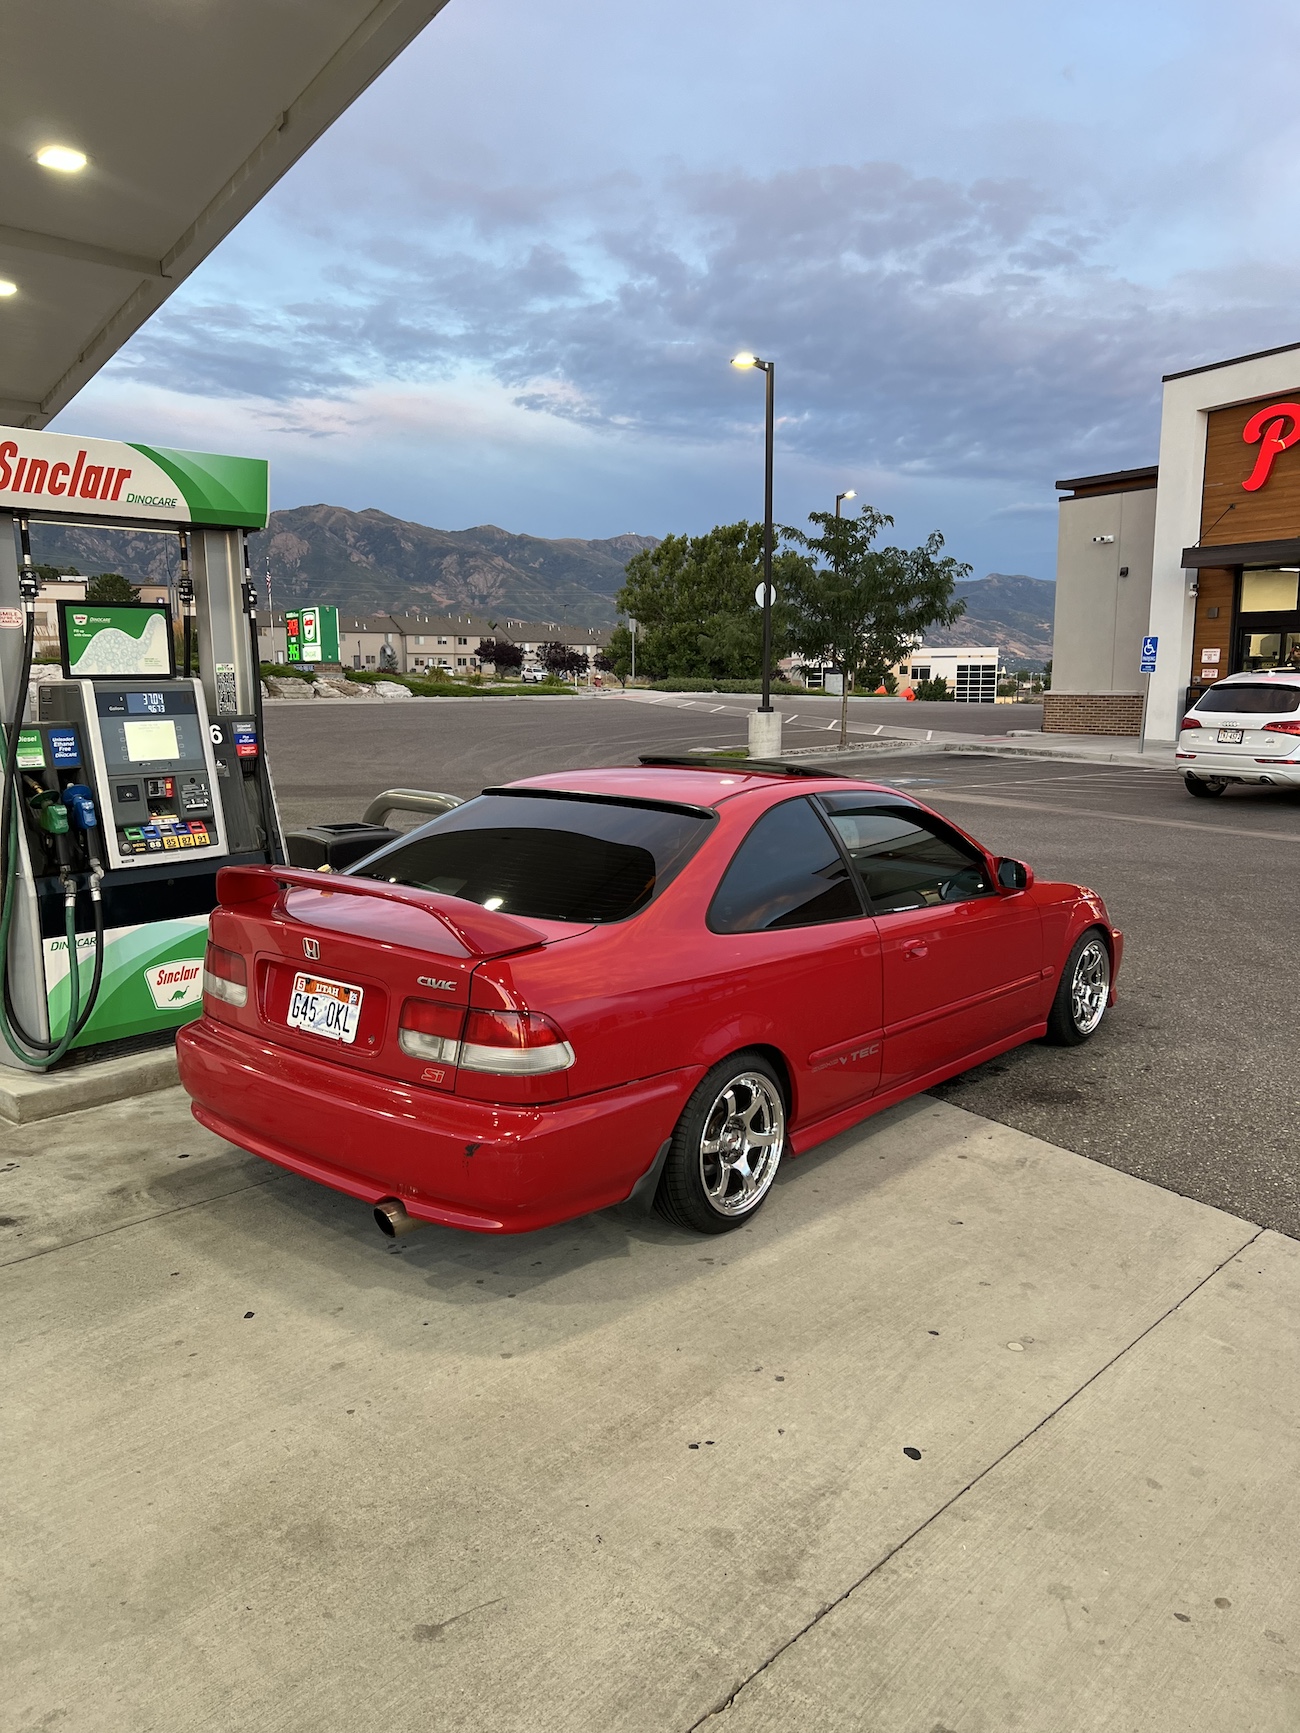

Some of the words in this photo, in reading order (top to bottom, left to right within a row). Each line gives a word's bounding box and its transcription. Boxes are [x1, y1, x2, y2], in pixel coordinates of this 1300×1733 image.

[0, 441, 132, 501] Sinclair
[126, 493, 178, 507] DINOCARE
[209, 724, 223, 744] 6
[50, 936, 97, 952] DINCAR
[156, 966, 200, 986] Sinclair
[417, 976, 457, 991] CIVIC
[315, 983, 339, 997] UTAH
[292, 993, 319, 1022] G45
